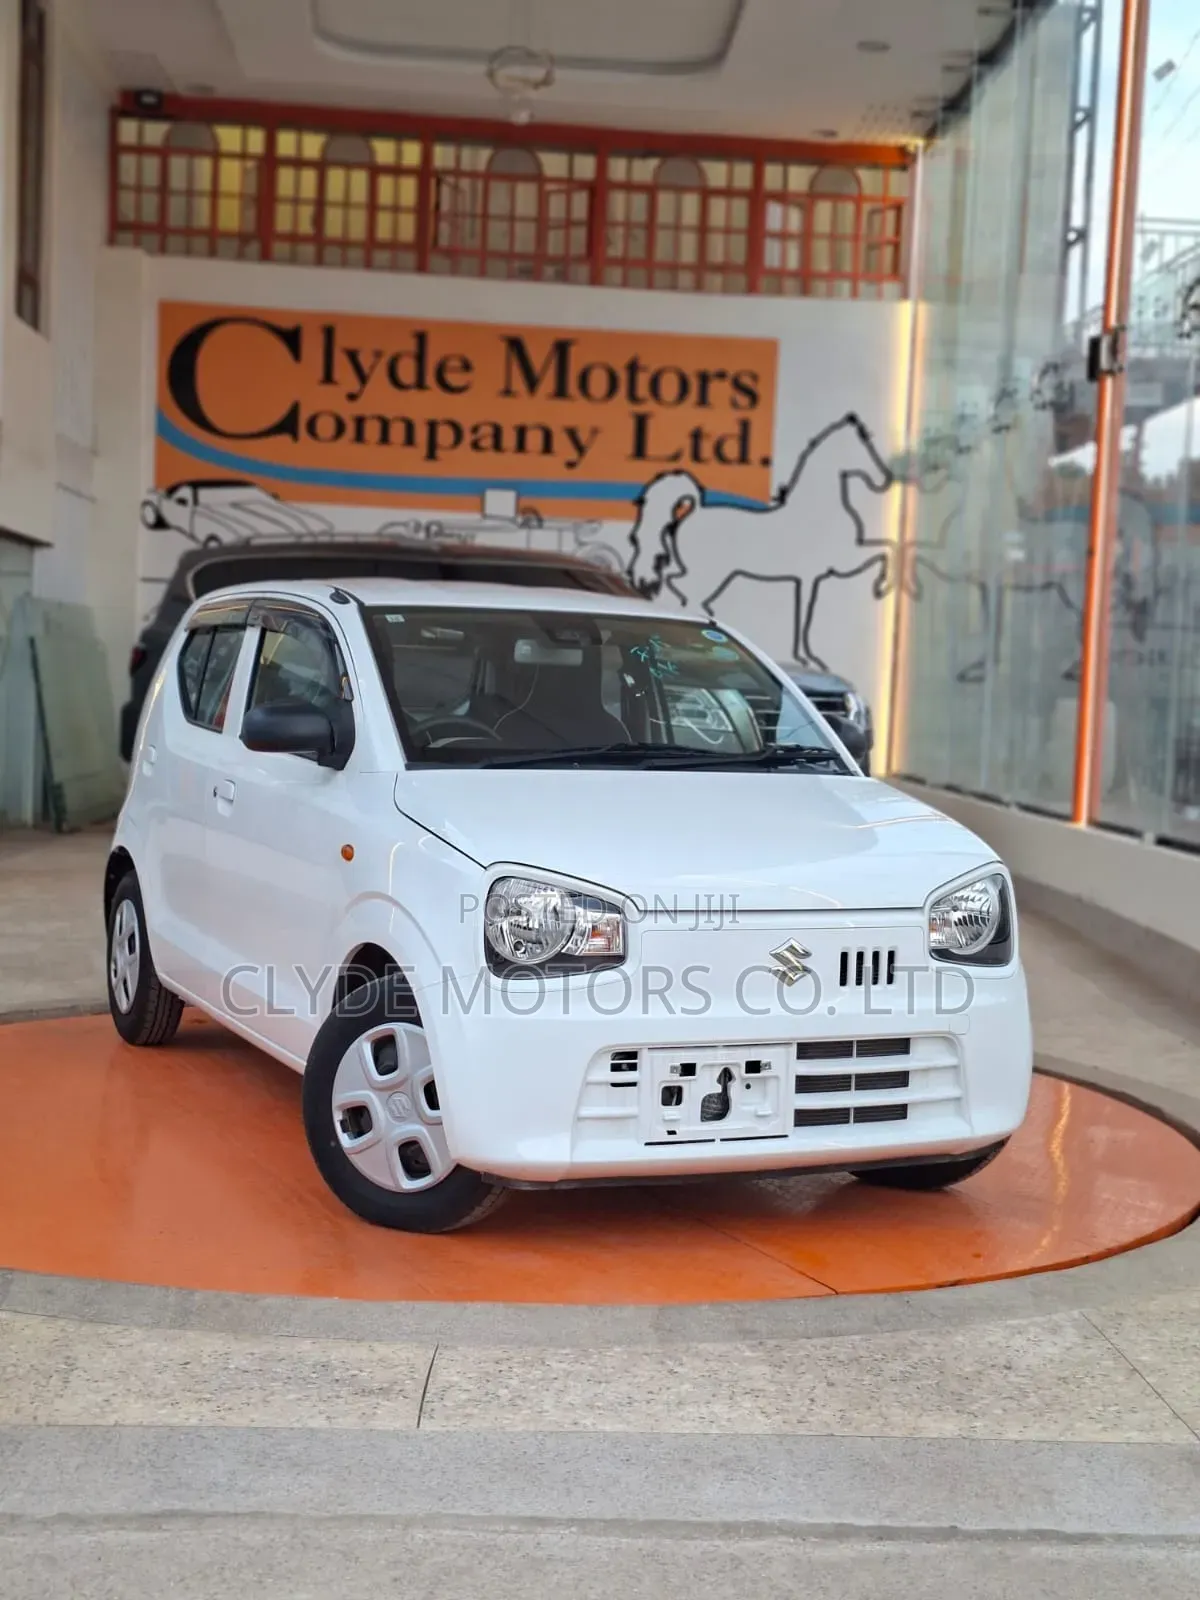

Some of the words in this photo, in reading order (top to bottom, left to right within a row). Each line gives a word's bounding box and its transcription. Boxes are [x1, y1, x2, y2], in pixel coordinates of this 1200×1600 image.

[166, 315, 475, 444] Clyde
[498, 334, 760, 411] Motors
[627, 410, 773, 467] Ltd.
